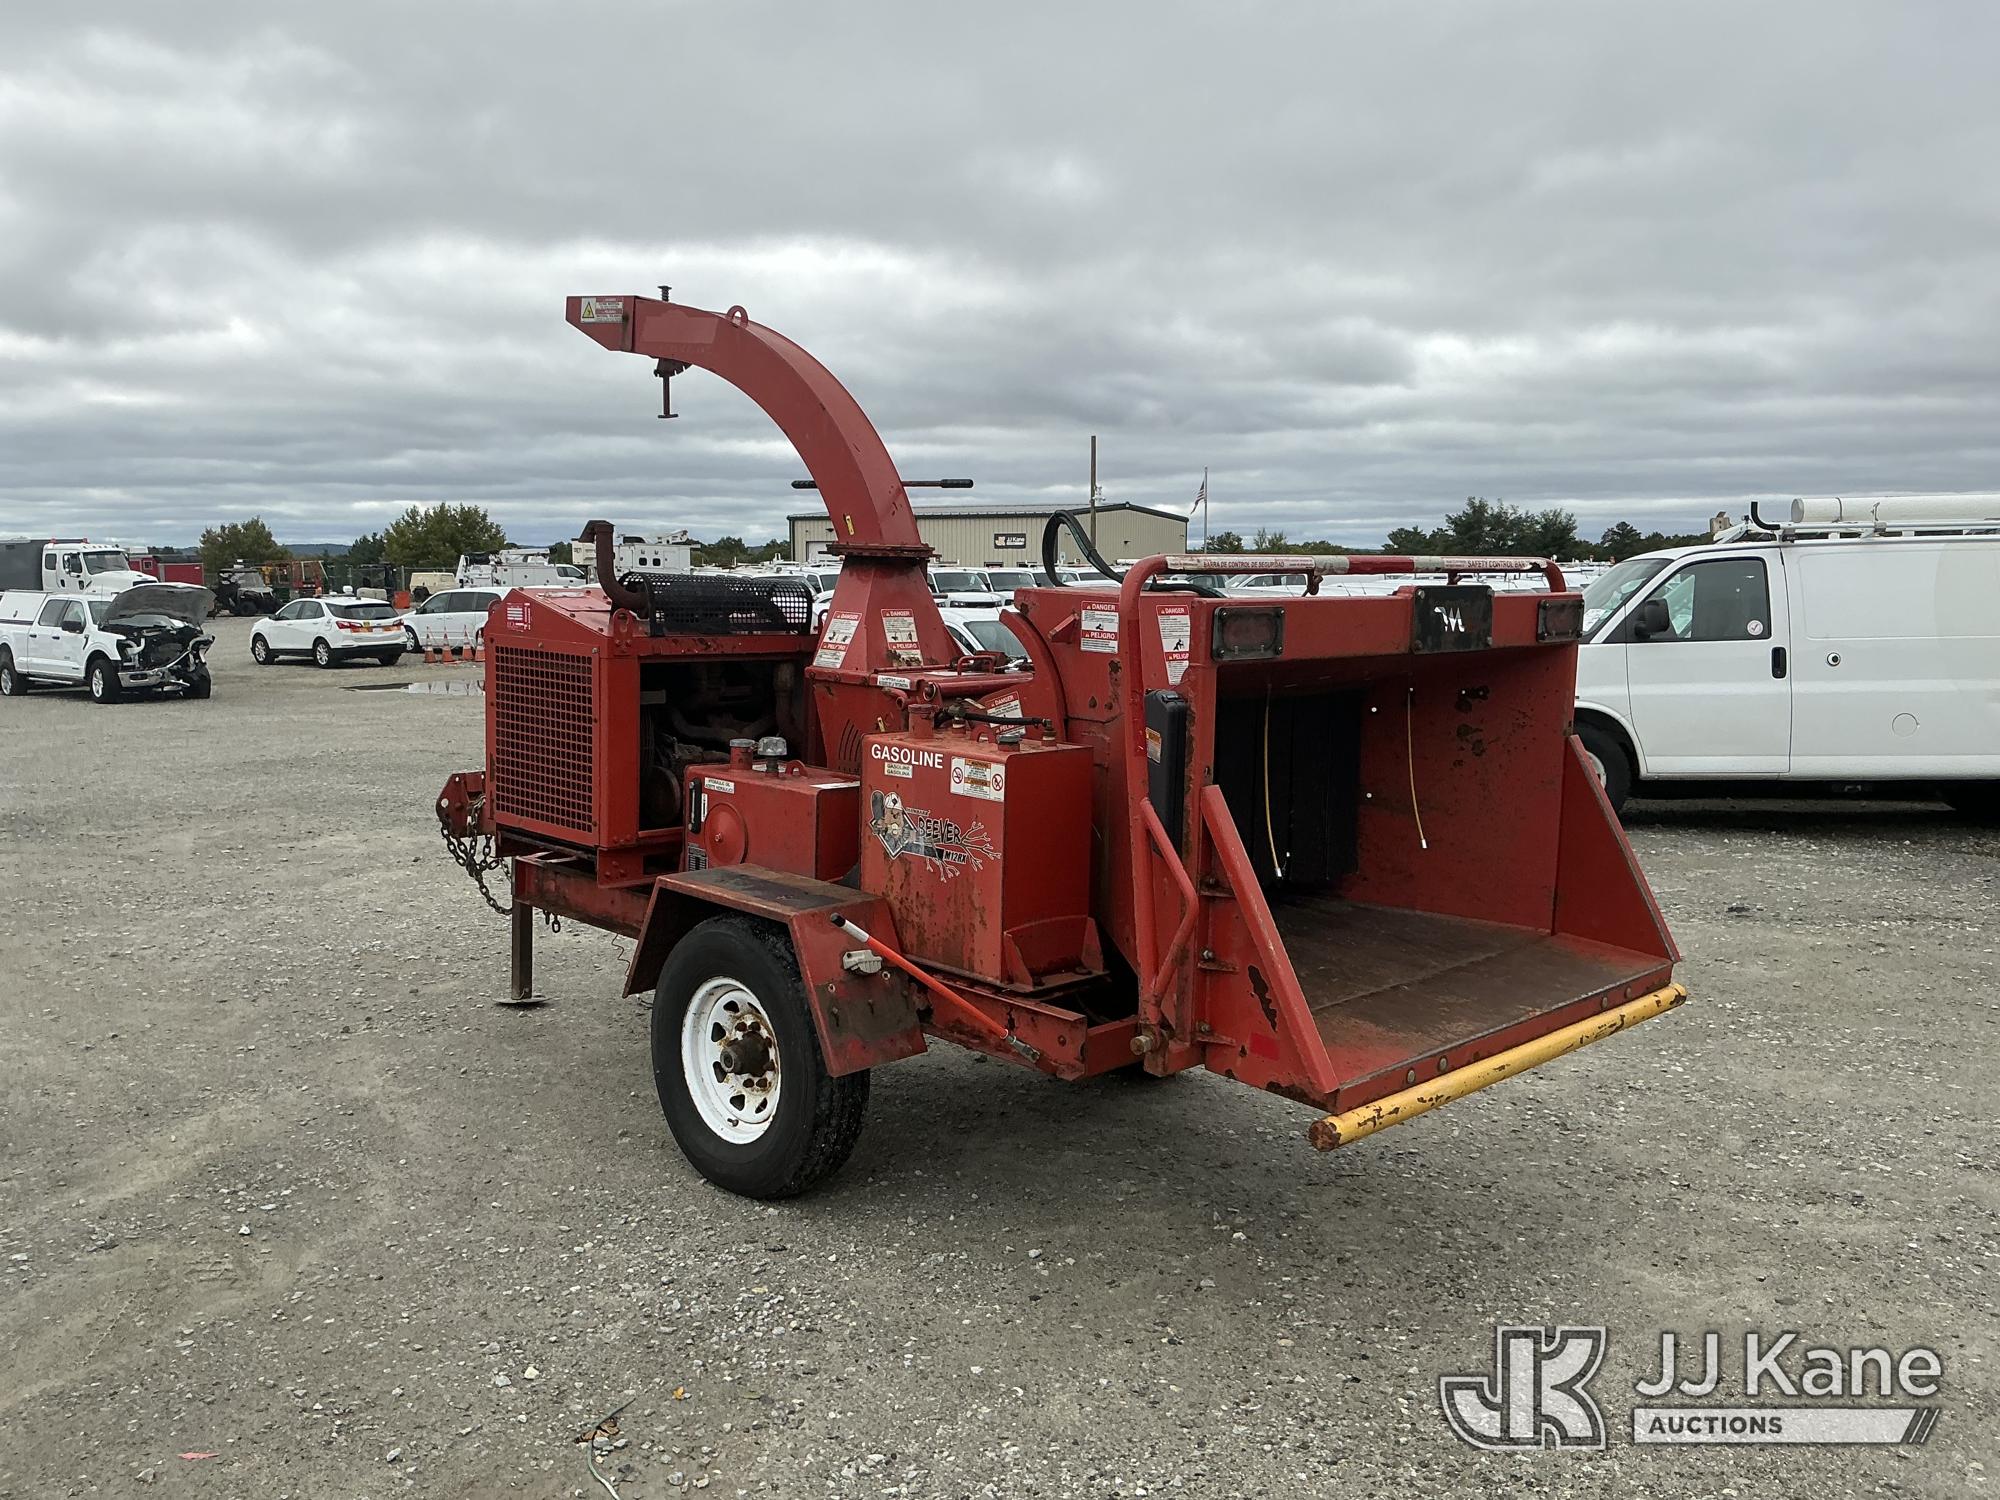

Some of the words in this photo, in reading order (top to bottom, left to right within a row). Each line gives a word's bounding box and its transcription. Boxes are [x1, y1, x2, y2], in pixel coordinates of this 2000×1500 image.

[1467, 560, 1488, 568] SAFETY
[1488, 560, 1514, 568] CONTROL
[1091, 603, 1116, 611] DANGER
[1090, 631, 1116, 640] PELIGRO
[994, 694, 1014, 706] DANGER
[871, 743, 944, 769] GASOLINE
[917, 816, 961, 845] BEEVER
[944, 850, 967, 864] M12RX
